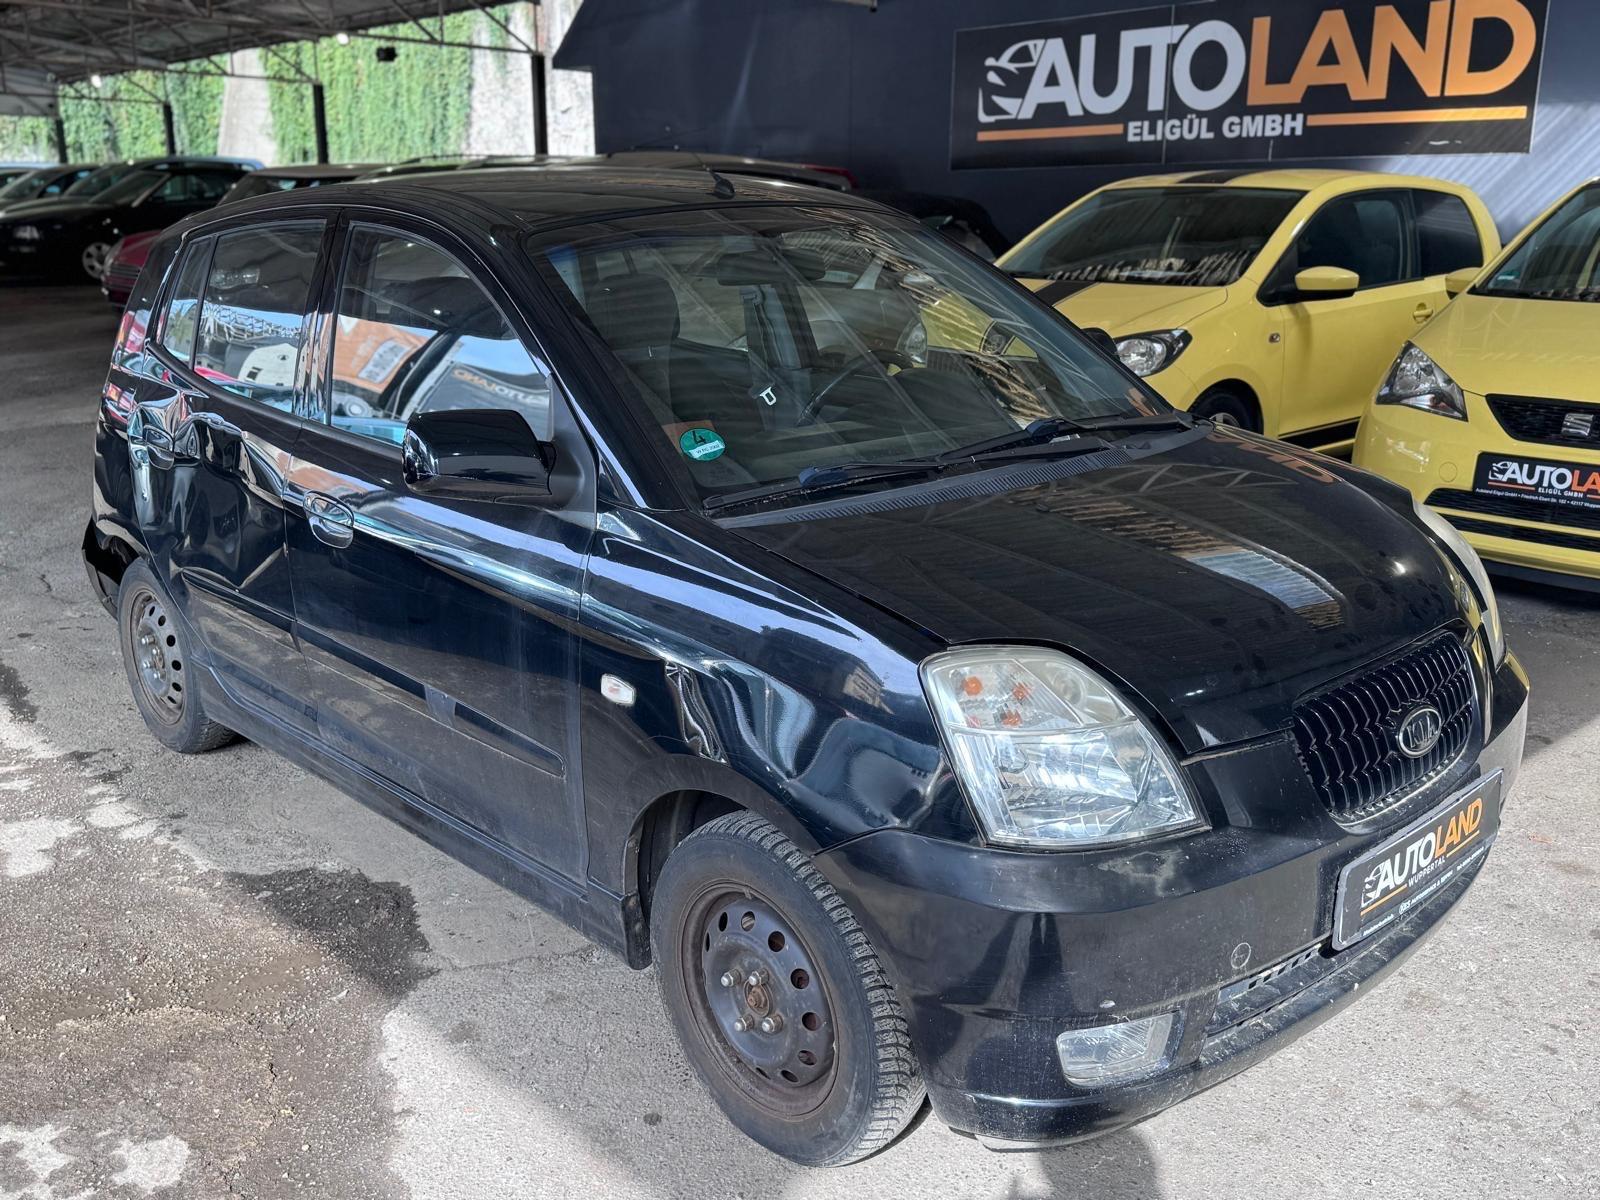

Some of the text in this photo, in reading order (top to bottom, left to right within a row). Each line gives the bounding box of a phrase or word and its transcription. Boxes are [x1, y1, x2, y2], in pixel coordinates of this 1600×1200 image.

[1017, 0, 1536, 119] AUTOLAND
[1127, 113, 1304, 142] ELIGÜL GMBH
[1538, 487, 1584, 498] ELIGÜL GMBH
[1406, 711, 1439, 748] KIA
[1374, 797, 1483, 900] AUTOLAND
[1408, 855, 1446, 888] WUPPERTAL
